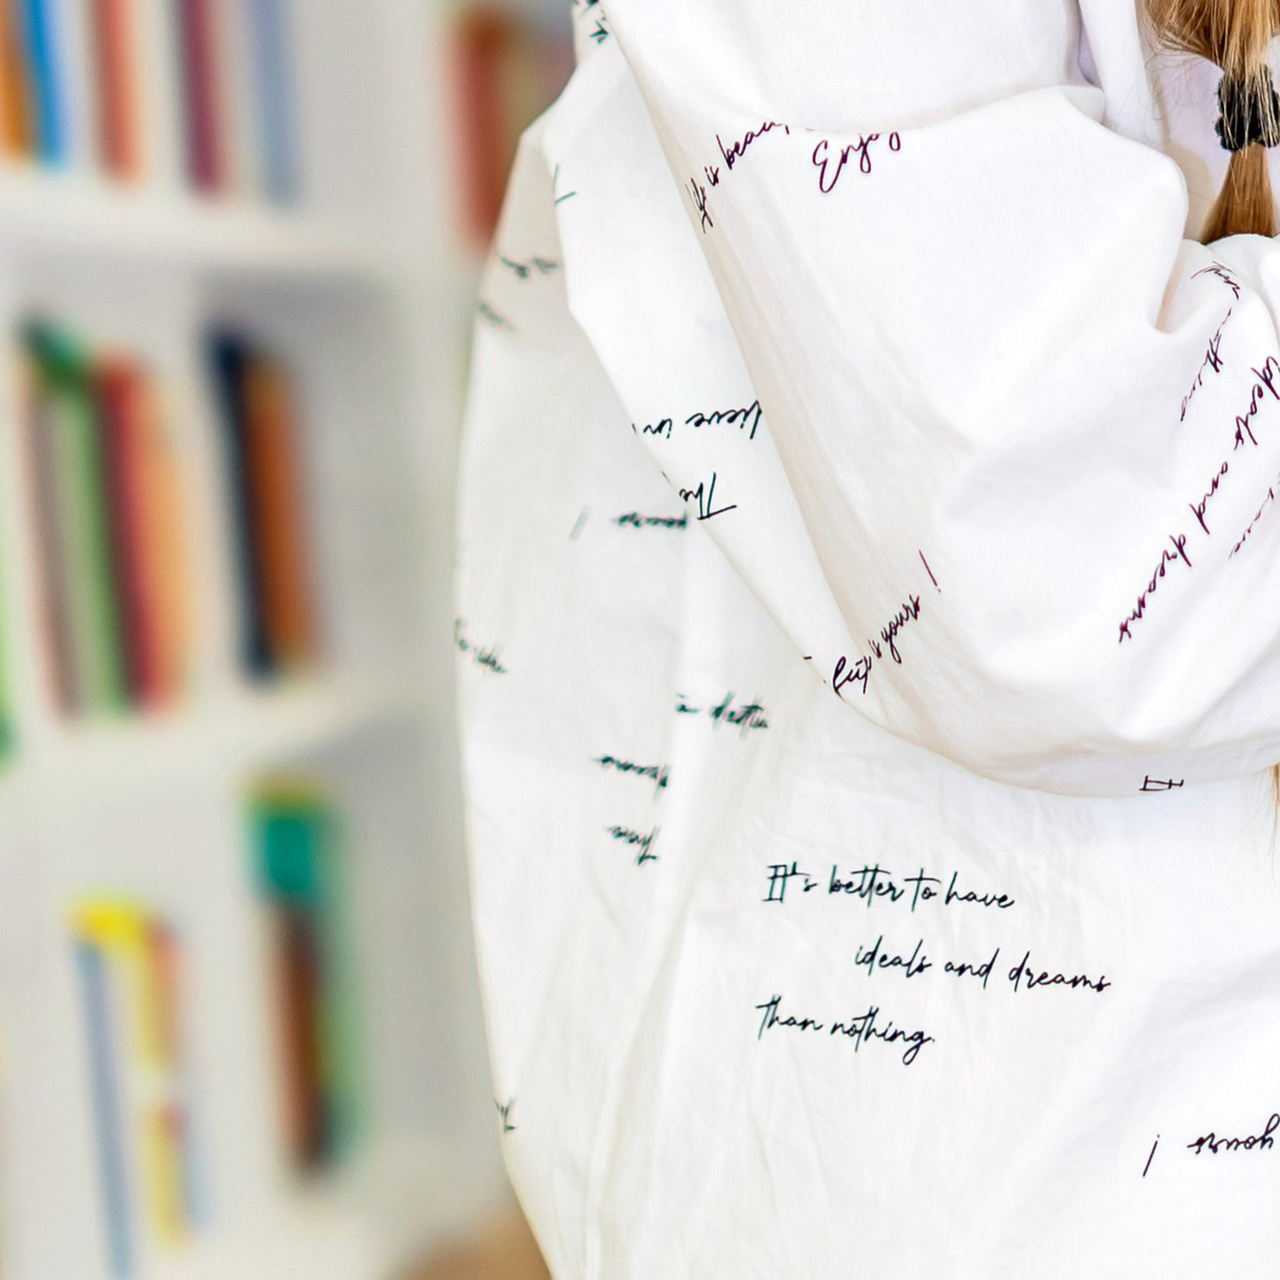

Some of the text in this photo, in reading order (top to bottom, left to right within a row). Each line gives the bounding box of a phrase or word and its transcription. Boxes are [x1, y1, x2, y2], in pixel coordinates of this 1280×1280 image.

[1188, 461, 1229, 536] and
[827, 861, 907, 910] better
[944, 870, 1016, 909] have
[854, 934, 1112, 993] ideals and dreams
[755, 994, 824, 1040] than
[1186, 1112, 1280, 1156] yours
